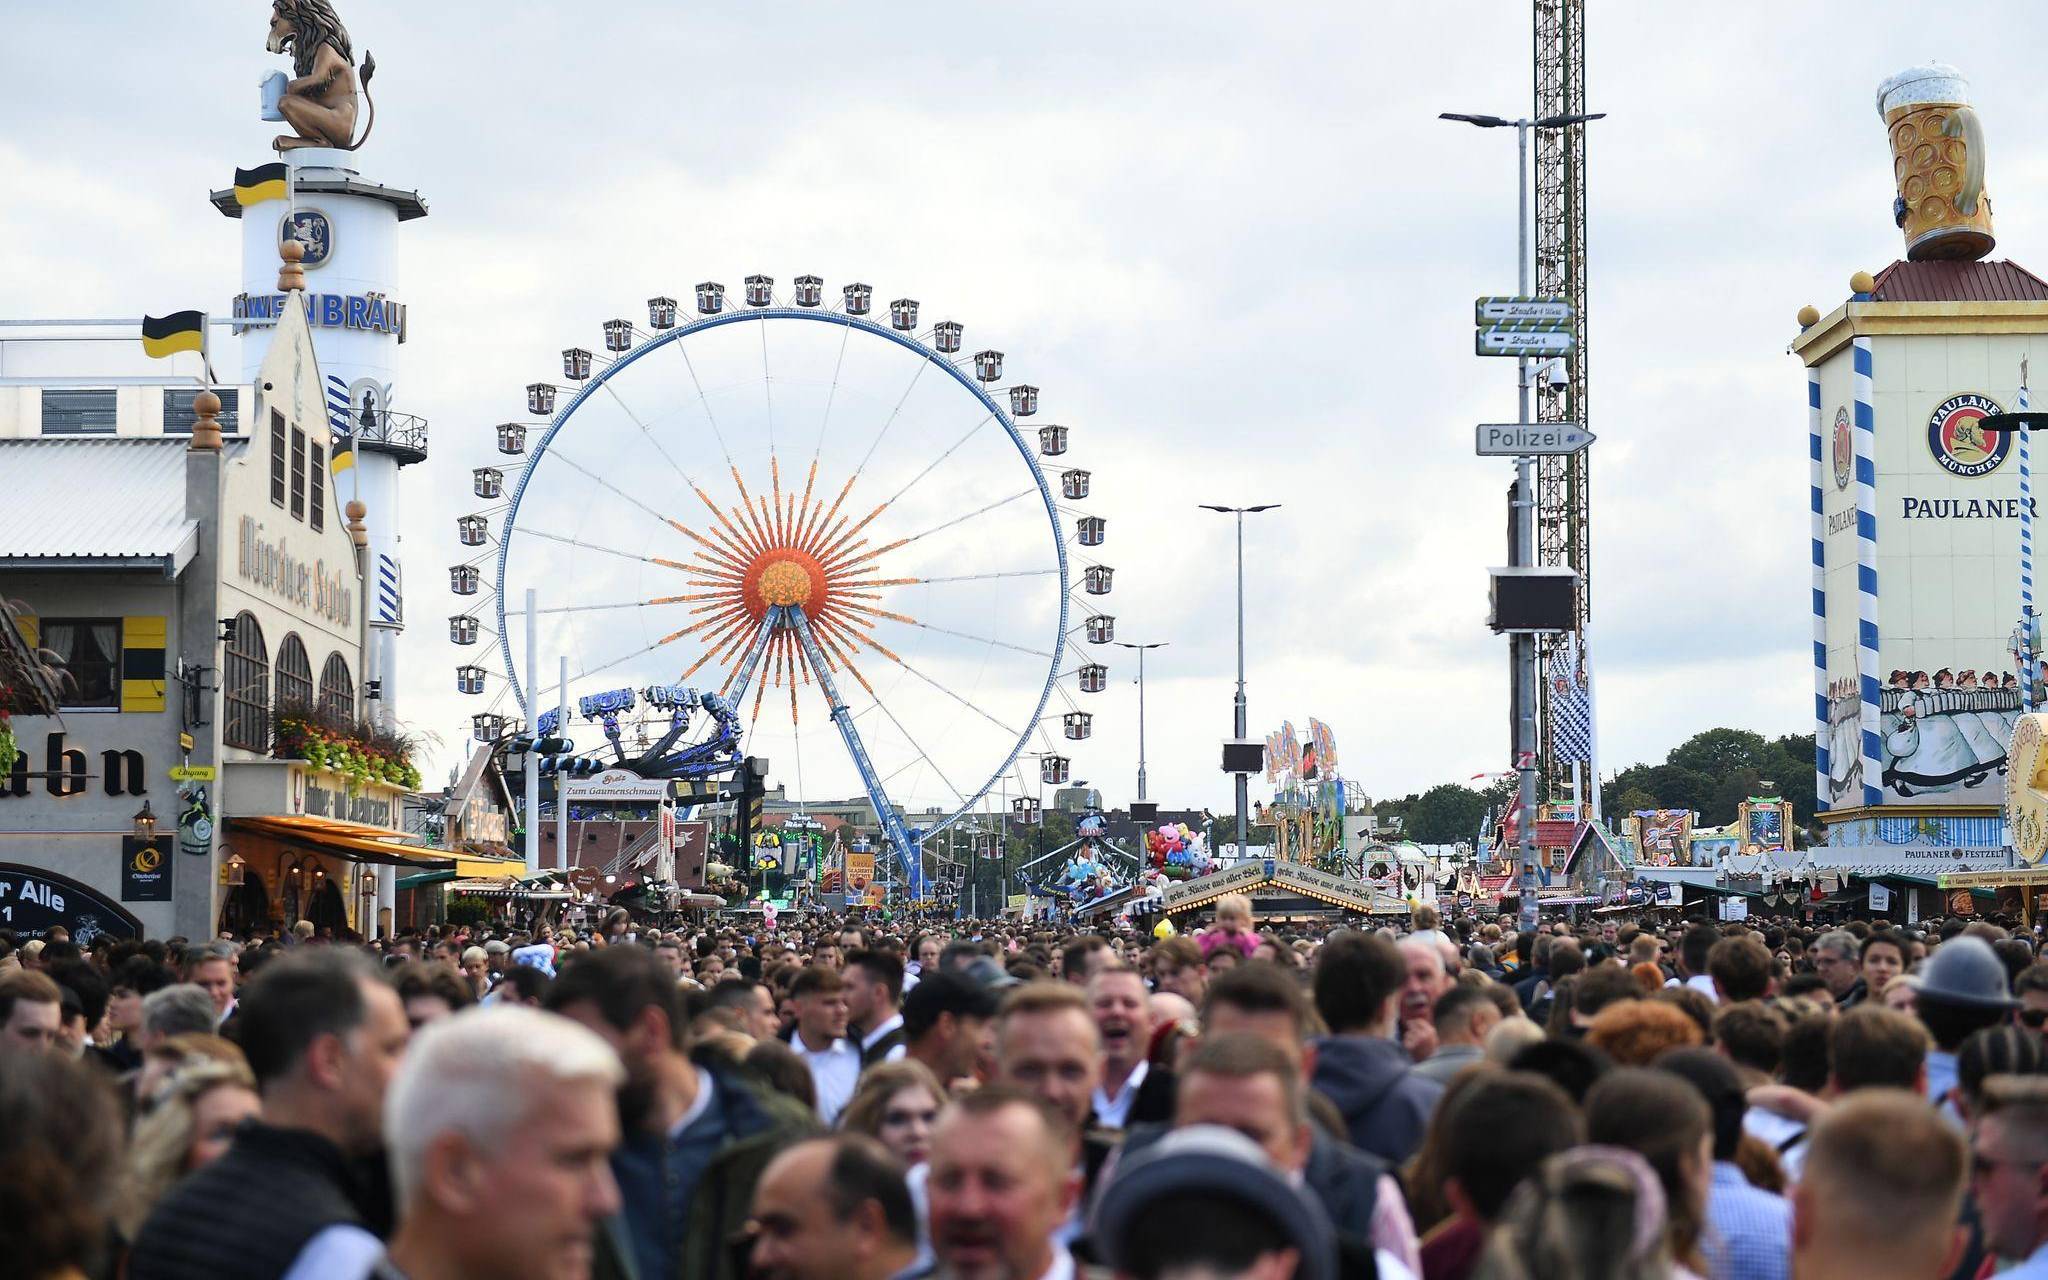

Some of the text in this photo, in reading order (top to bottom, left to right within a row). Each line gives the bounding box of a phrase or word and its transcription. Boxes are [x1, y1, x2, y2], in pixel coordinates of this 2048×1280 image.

[1932, 396, 2002, 426] PAULANE
[1489, 429, 1562, 447] Polizei
[1828, 504, 1857, 536] PAULANE
[178, 768, 209, 778] Eingang
[567, 787, 663, 795] Zum Gaumenschmaus
[1904, 849, 2004, 859] PAULANER FESTZELT
[20, 880, 65, 912] Alle
